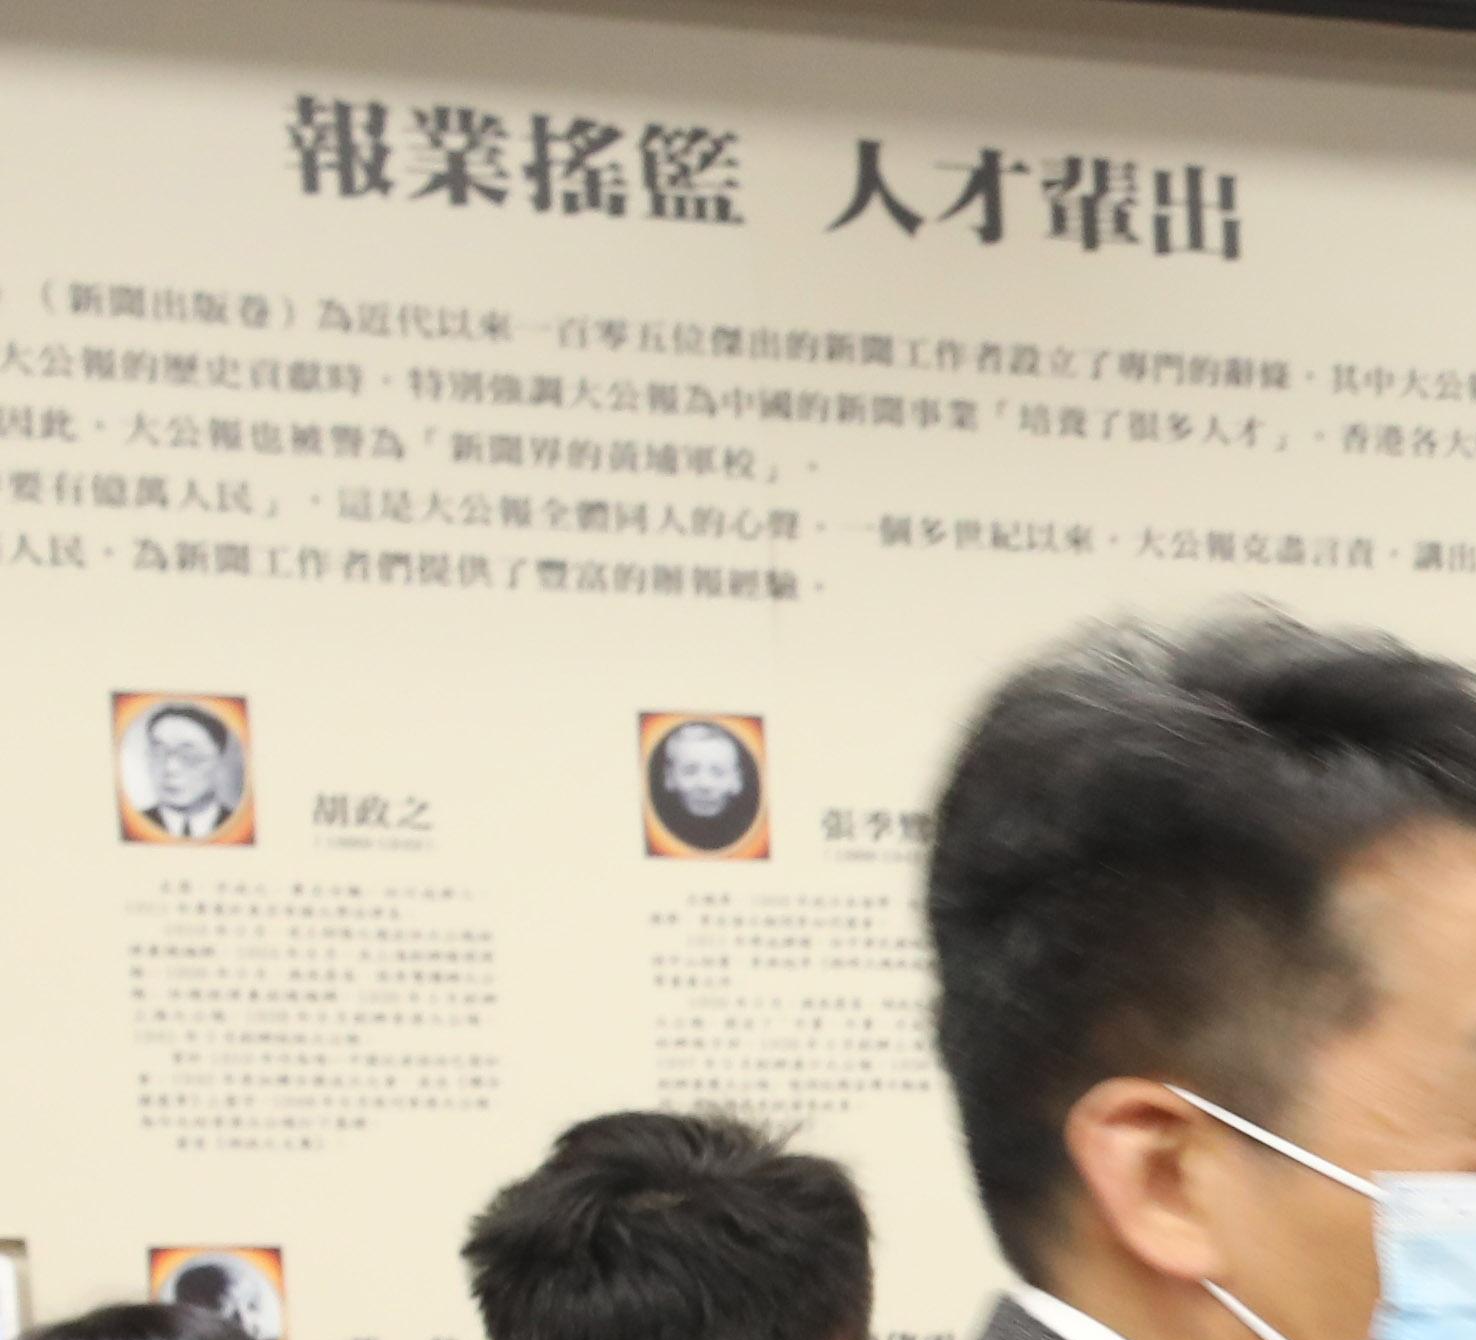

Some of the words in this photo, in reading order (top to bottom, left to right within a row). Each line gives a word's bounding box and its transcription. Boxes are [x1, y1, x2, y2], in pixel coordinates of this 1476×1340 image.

[286, 92, 746, 227] 報業搖籃
[826, 138, 1242, 261] 人才輩出
[313, 792, 433, 831] 胡政之
